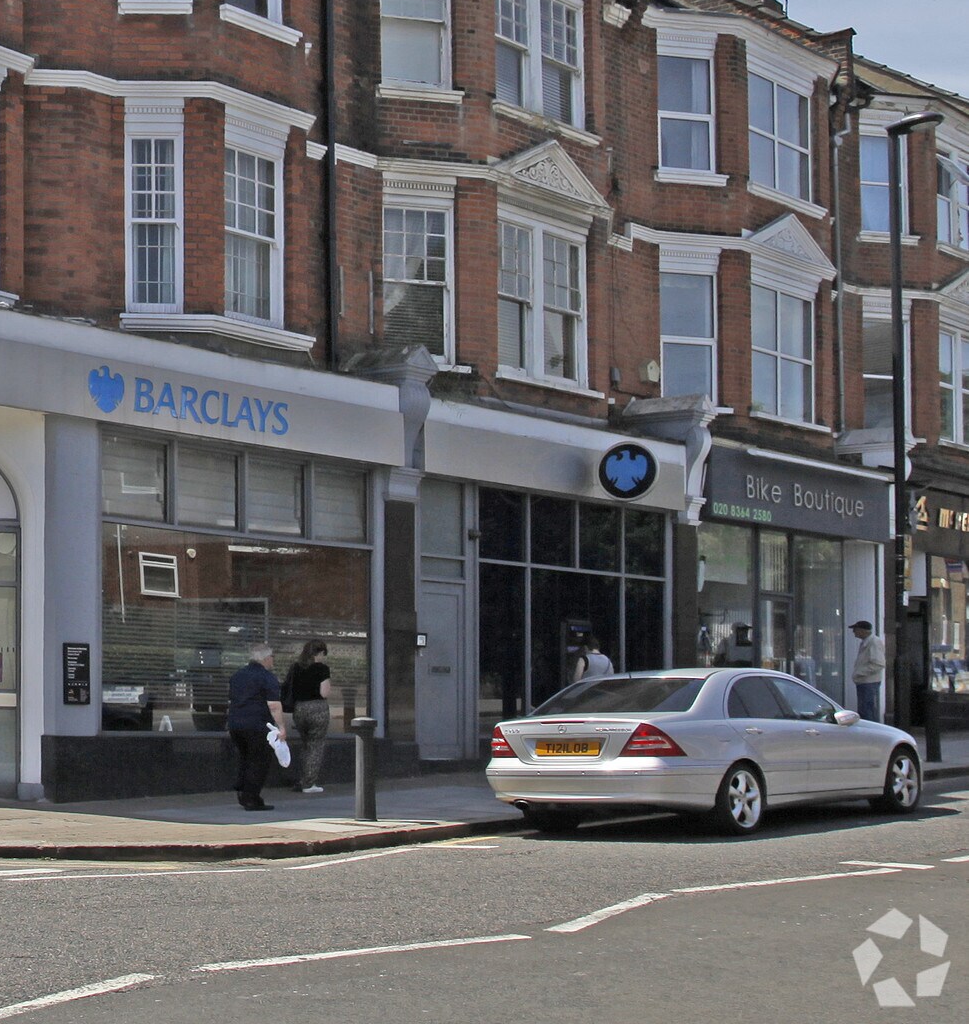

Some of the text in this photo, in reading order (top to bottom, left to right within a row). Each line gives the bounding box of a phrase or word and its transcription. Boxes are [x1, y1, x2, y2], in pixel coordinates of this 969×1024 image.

[134, 377, 289, 435] BARCLAYS
[713, 502, 728, 516] 020
[746, 474, 865, 519] Bike Boutique
